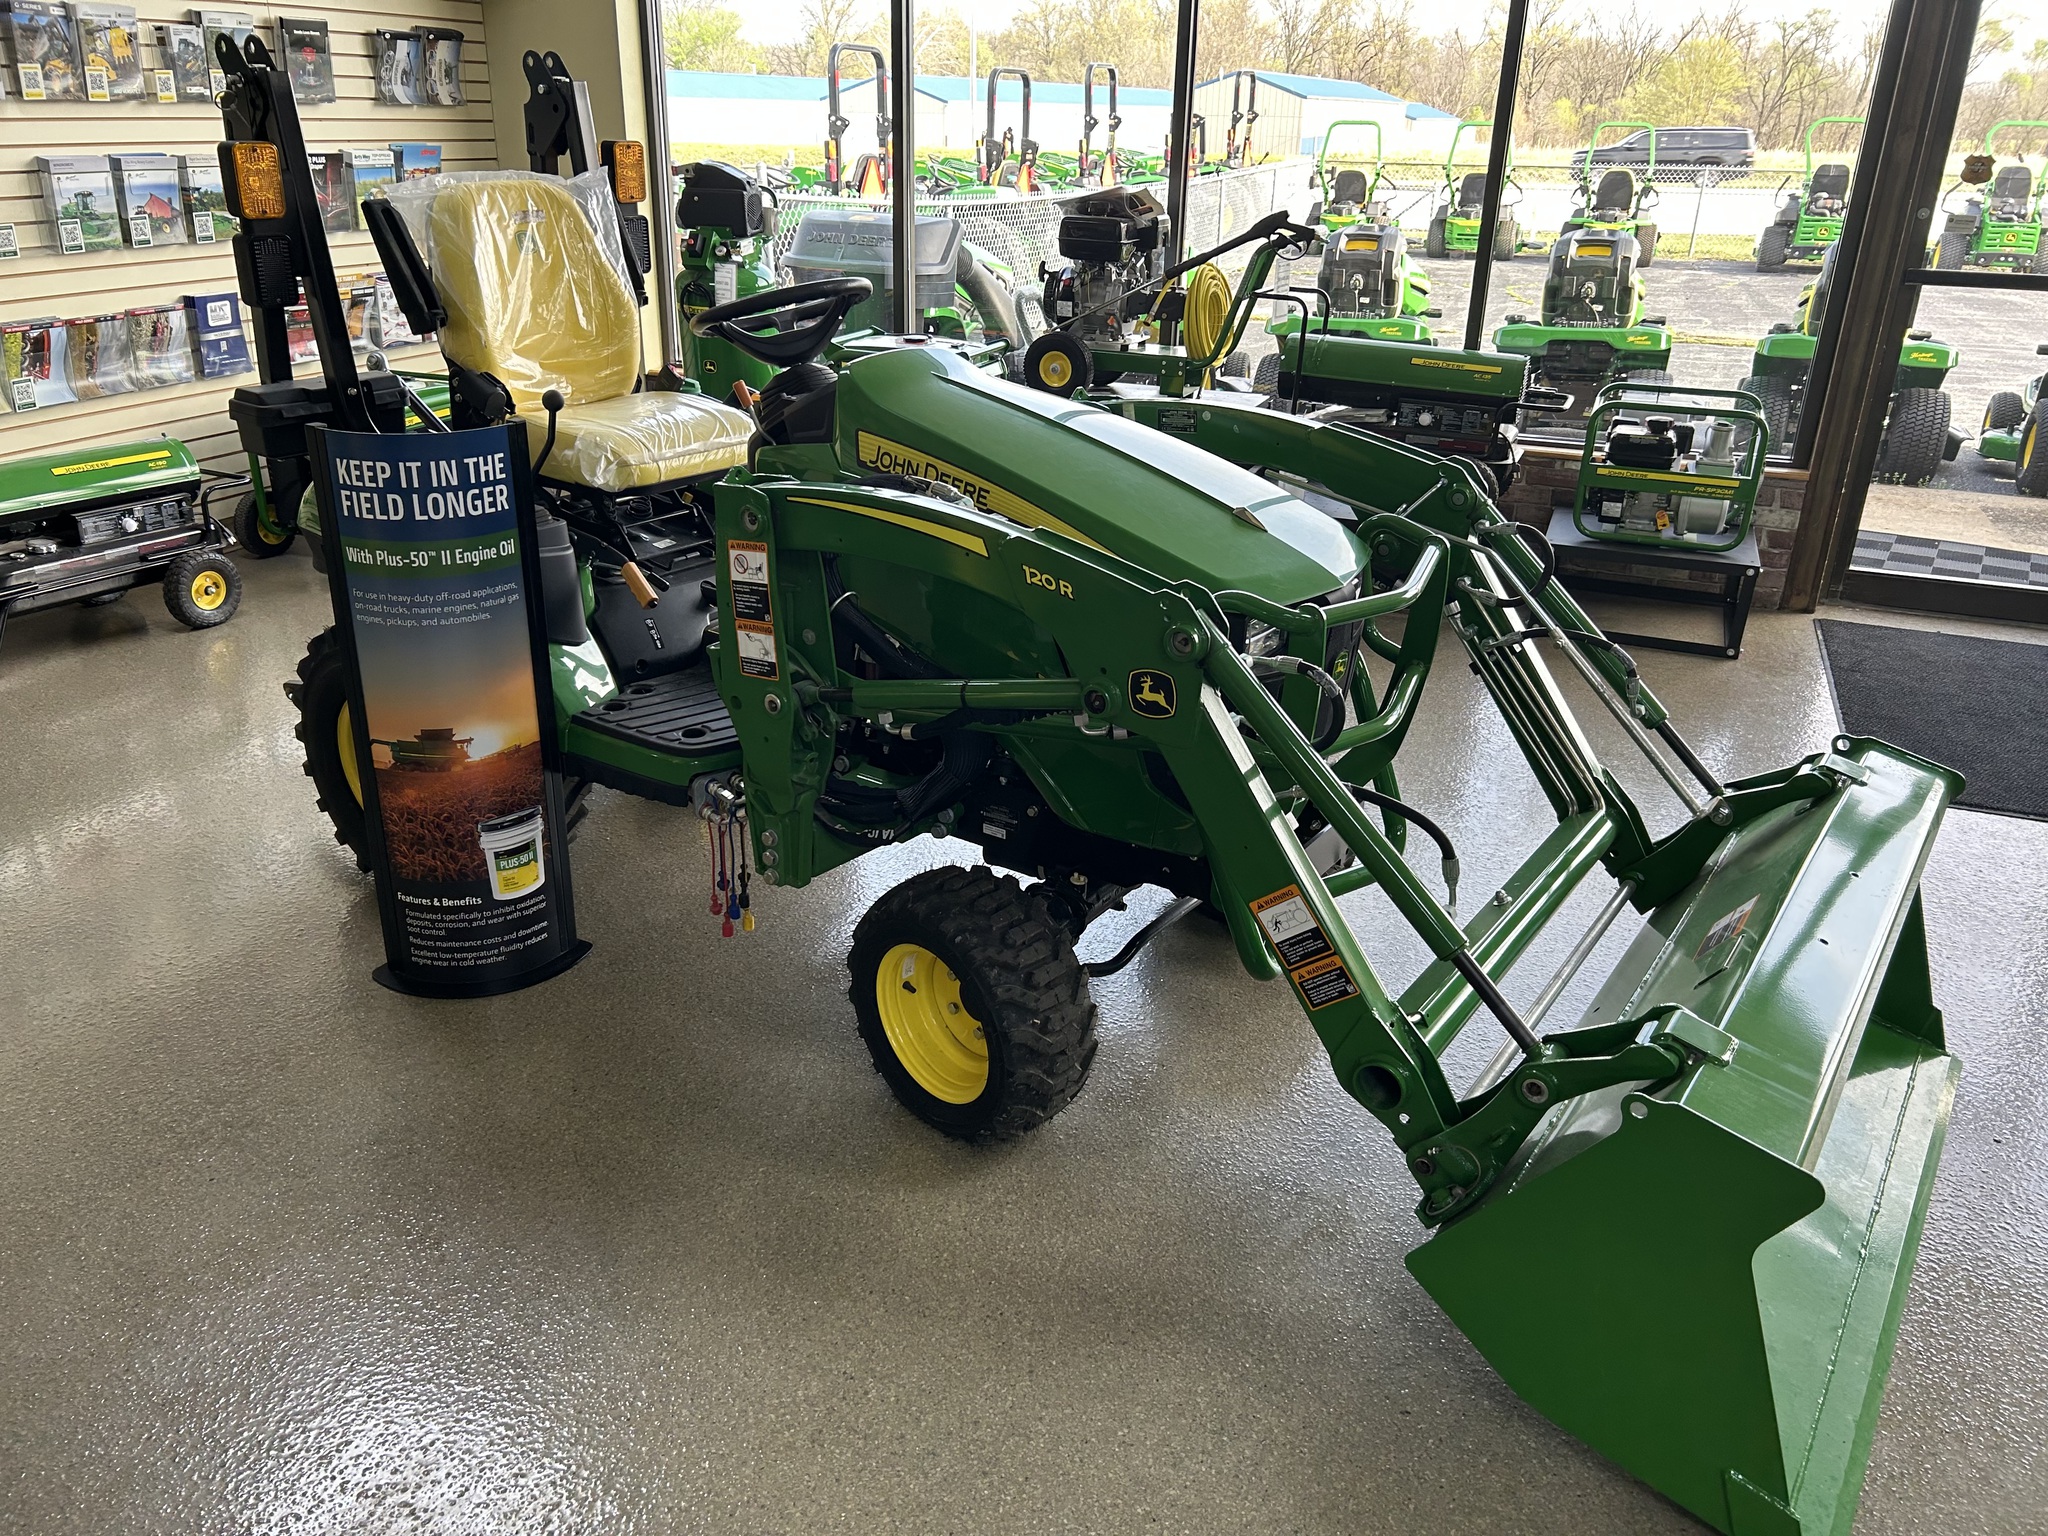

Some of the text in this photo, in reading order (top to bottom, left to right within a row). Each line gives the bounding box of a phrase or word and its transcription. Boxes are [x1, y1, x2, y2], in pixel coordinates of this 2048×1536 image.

[807, 231, 846, 245] JOHN
[1420, 359, 1466, 369] JOHN DEERE
[65, 461, 110, 474] JOHN DEERE
[869, 445, 920, 478] JOHN
[335, 452, 507, 489] KEEP IT IN THE
[1625, 471, 1649, 479] DEERE
[340, 484, 510, 521] FIELD LONGER
[346, 545, 374, 565] With
[455, 545, 497, 568] Engine
[500, 538, 516, 556] Oil
[735, 543, 766, 551] WARNING
[353, 582, 518, 604] For use in heavy-duty off-road applications,
[355, 593, 520, 615] on-road trucks, marine engines, natural gas
[356, 612, 492, 628] engines, pickups, and automobiles.
[741, 622, 773, 634] WARNING
[500, 853, 529, 870] PLUS-50
[397, 892, 482, 907] Features & Benefits
[1263, 889, 1294, 907] WARNING
[405, 895, 546, 921] Formulated specifically to inhibit oxidation,
[406, 901, 547, 929] deposits, corrosion, and wear with superior
[409, 920, 549, 948] Reduces maintenance costs and downtime.
[421, 928, 447, 936] control.
[411, 932, 548, 960] Excellent low-temperature fluidity reduces
[411, 954, 507, 967] engine wear in cold weather.
[1305, 960, 1337, 977] WARNING
